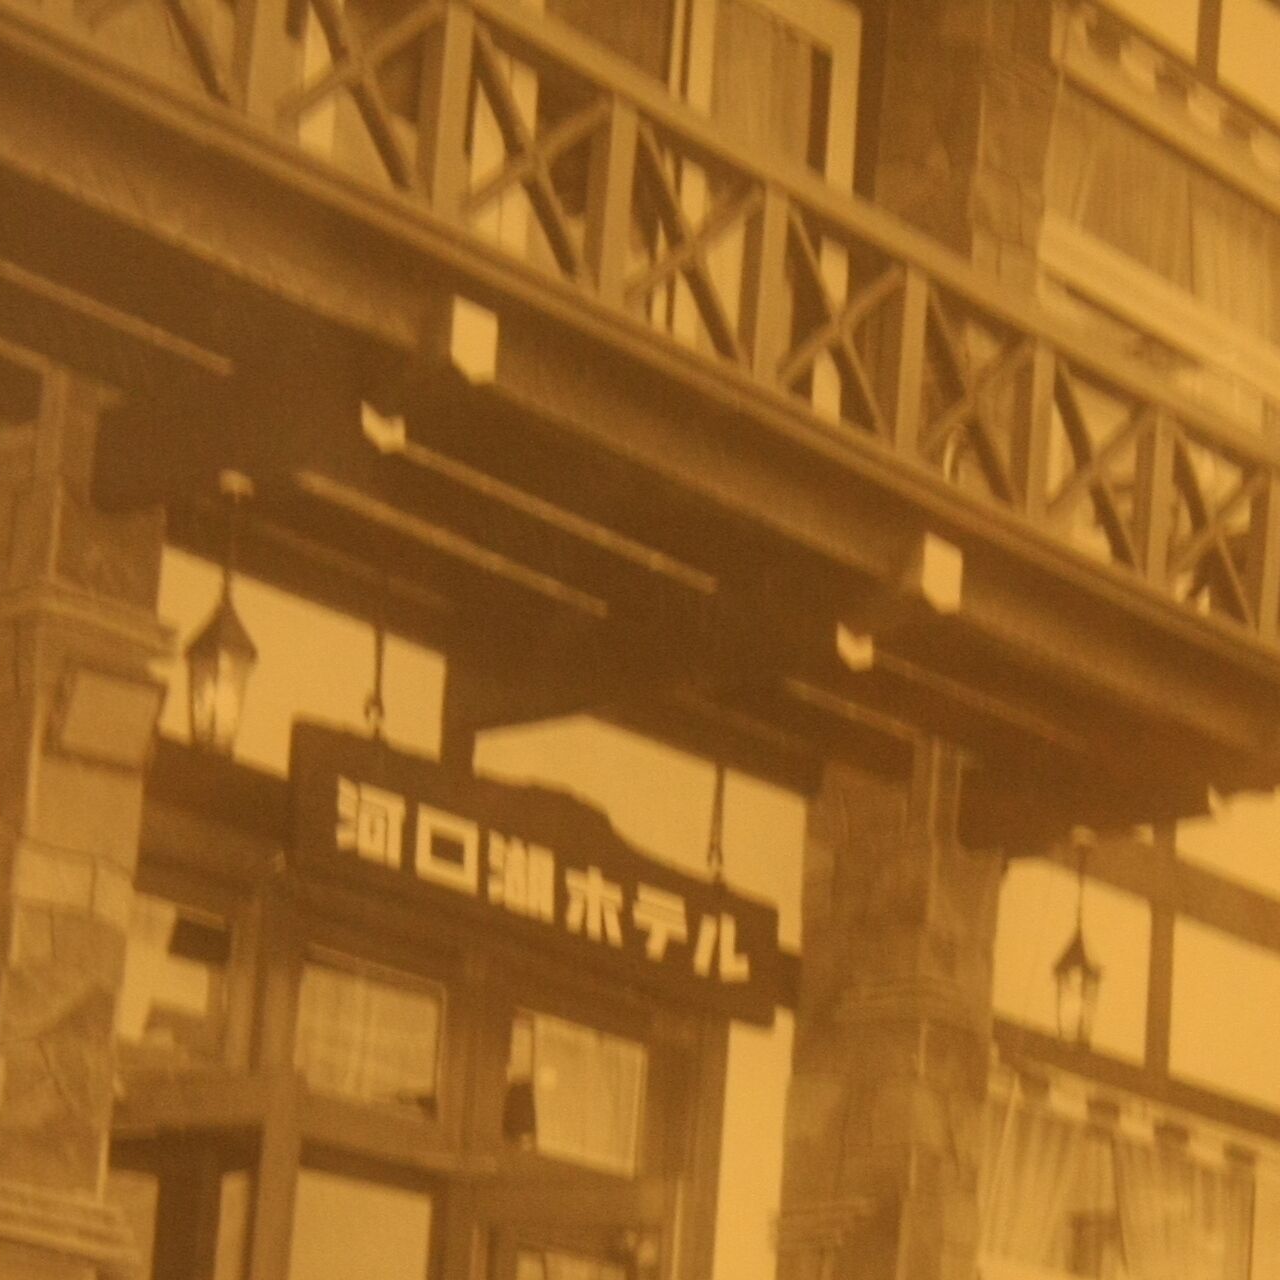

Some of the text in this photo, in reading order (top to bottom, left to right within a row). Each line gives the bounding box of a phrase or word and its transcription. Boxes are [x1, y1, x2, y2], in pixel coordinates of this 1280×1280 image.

[336, 775, 750, 983] 河口湖ホテル
